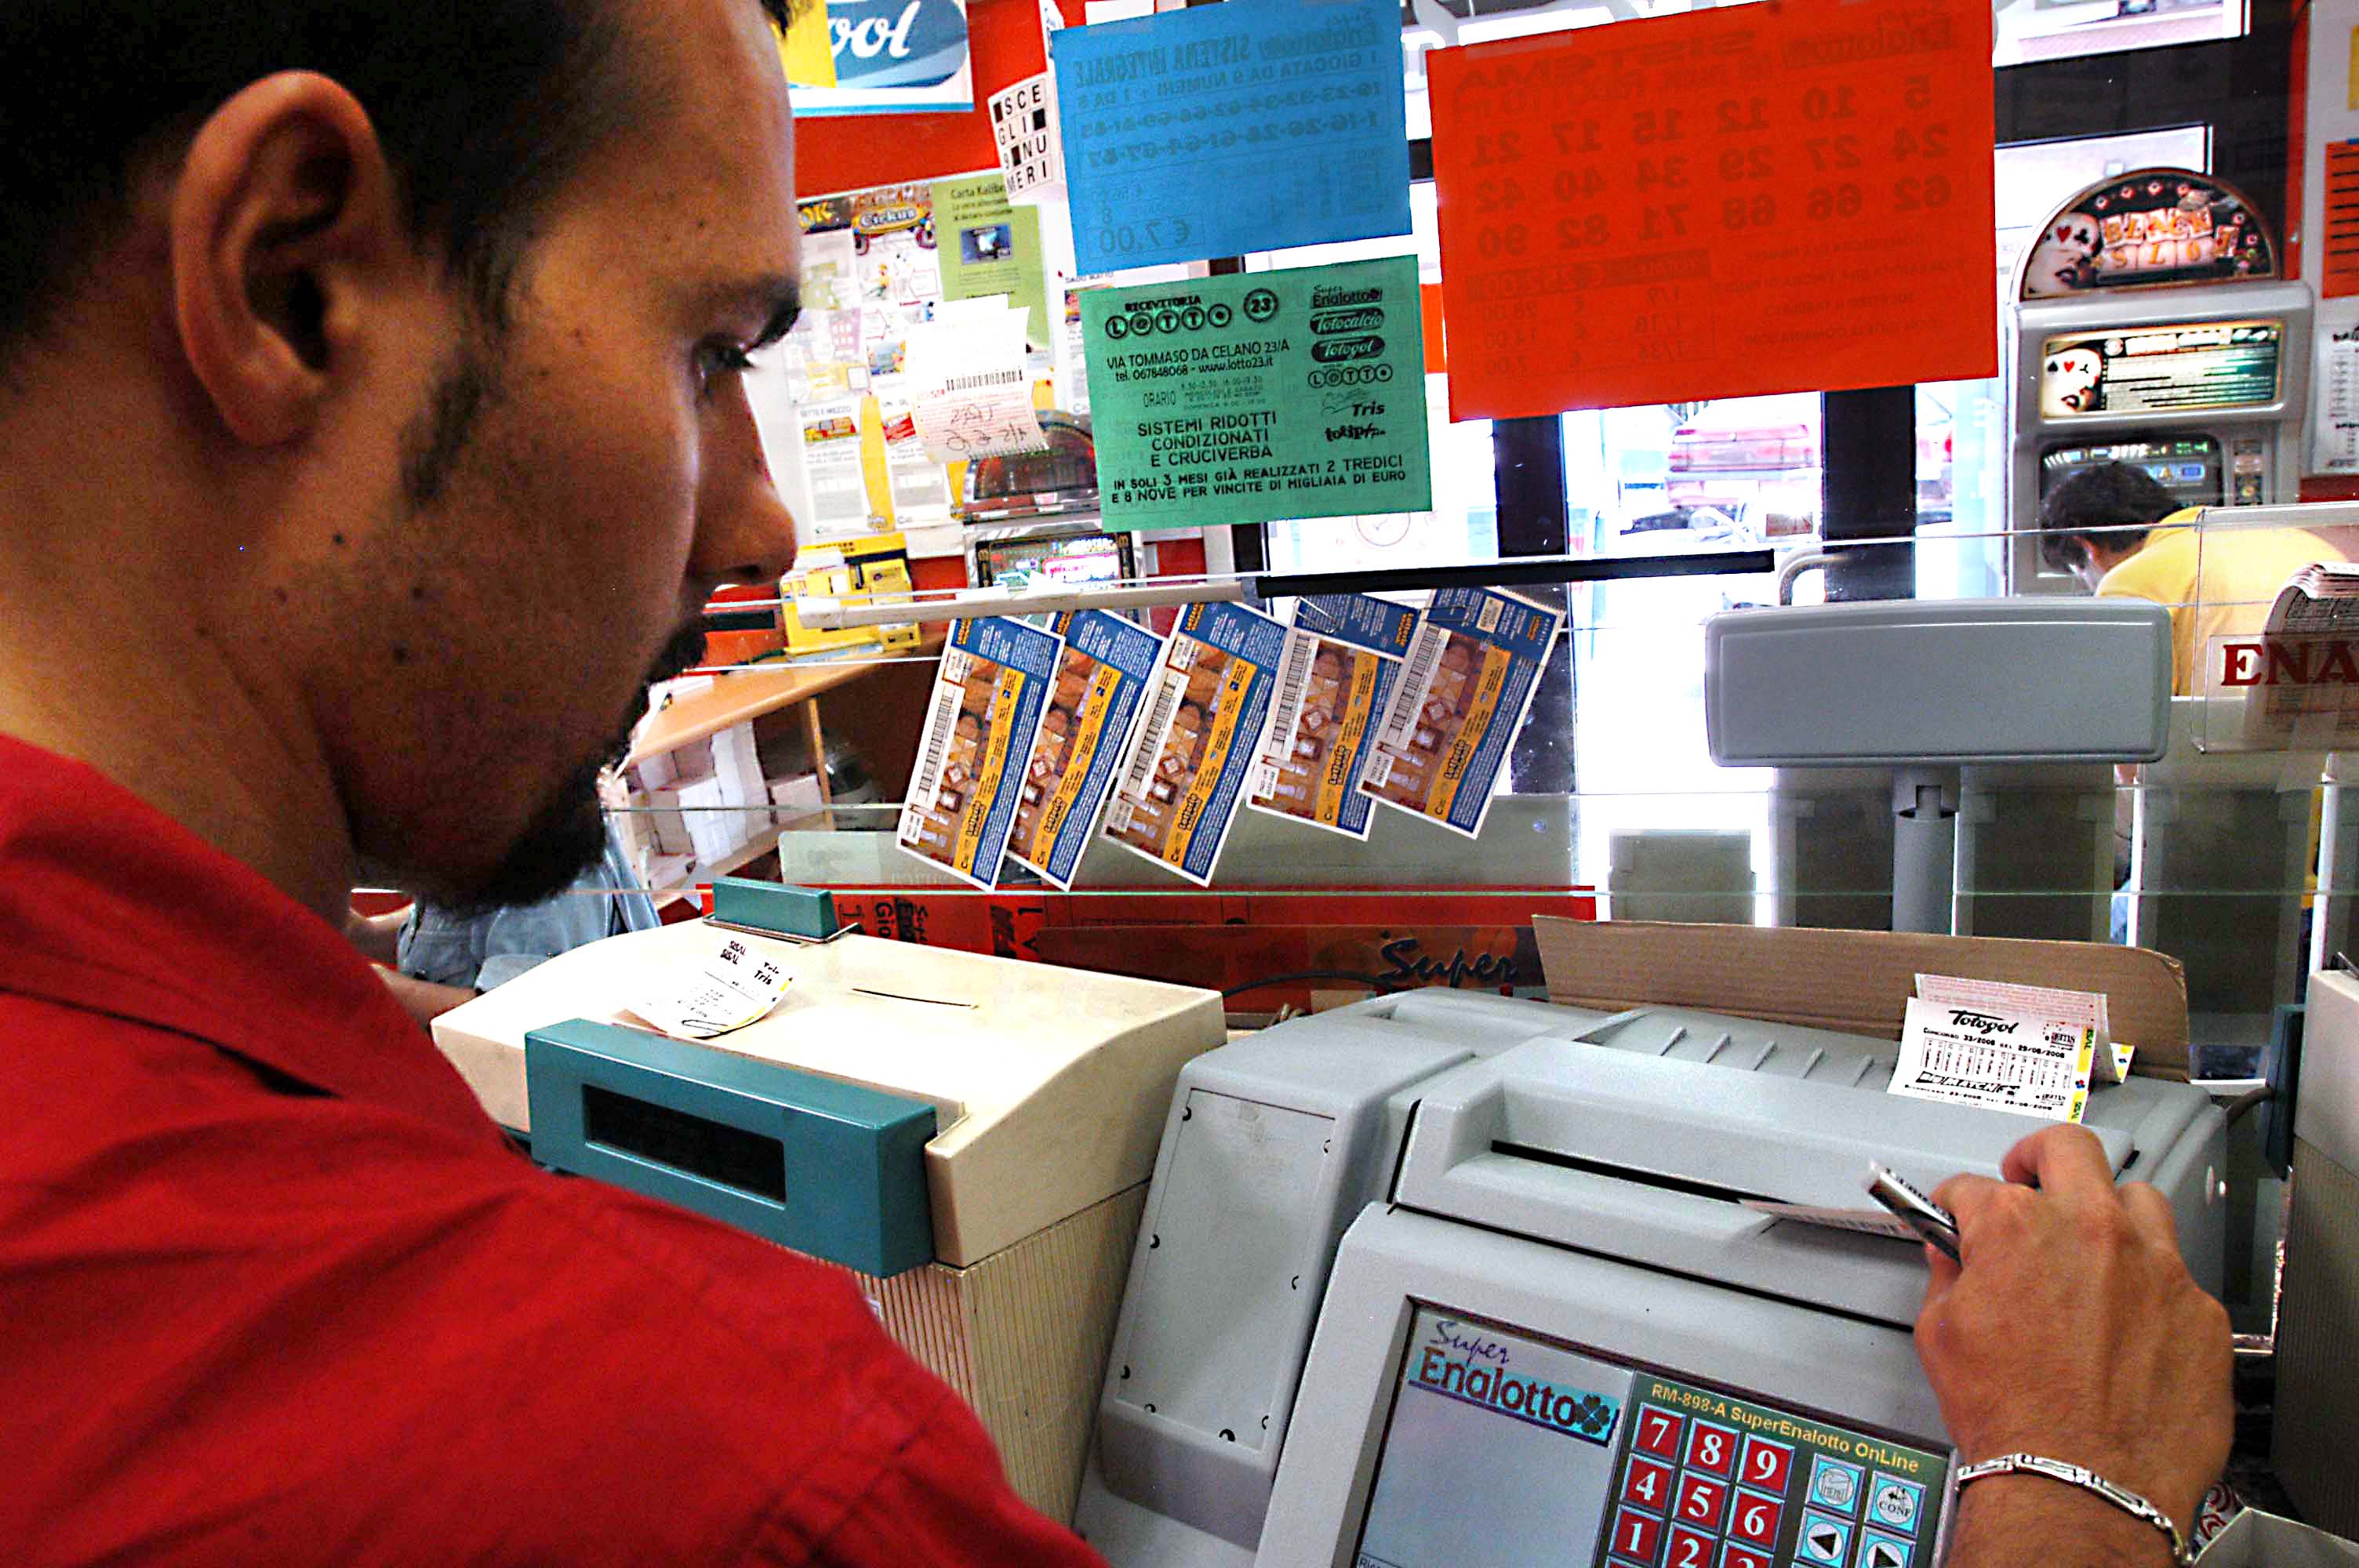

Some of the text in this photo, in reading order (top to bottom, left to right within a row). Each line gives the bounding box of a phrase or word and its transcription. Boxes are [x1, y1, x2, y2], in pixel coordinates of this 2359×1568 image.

[1316, 311, 1382, 332] Totocalcio
[1107, 357, 1125, 369] VIA
[1129, 350, 1188, 368] TOMMASO
[1192, 349, 1210, 361] DA
[1212, 342, 1261, 359] CELANO
[1325, 339, 1374, 357] Totogol
[1115, 372, 1130, 382] tel.
[1199, 357, 1274, 373] www.lotto23.it
[1143, 391, 1176, 408] ORARIO
[1352, 401, 1385, 417] Tris
[1138, 411, 1277, 437] SISTEMI RIDOTTI
[1152, 428, 1268, 451] CONDIZIONATI
[1150, 445, 1273, 467] E CRUCIVERBA
[1114, 455, 1402, 489] IN SOLI 3 MESI GIÀ REALIZZATI 2 TREDICI
[1112, 470, 1405, 503] E 8 NOVE PER VINCITE DI MIGLIAIA DI EURO
[1377, 938, 1518, 988] Super
[754, 970, 772, 985] Tris
[1948, 1010, 2019, 1034] Totogol
[1430, 1320, 1510, 1367] Super
[1420, 1345, 1576, 1427] Enalotto
[1650, 1417, 1777, 1481] 7 8 9
[1730, 1406, 1851, 1454] SuperEnalotto
[1854, 1440, 1920, 1473] OnLine
[1635, 1471, 1768, 1536] 4 5 6
[1627, 1522, 1702, 1568] 1 2
